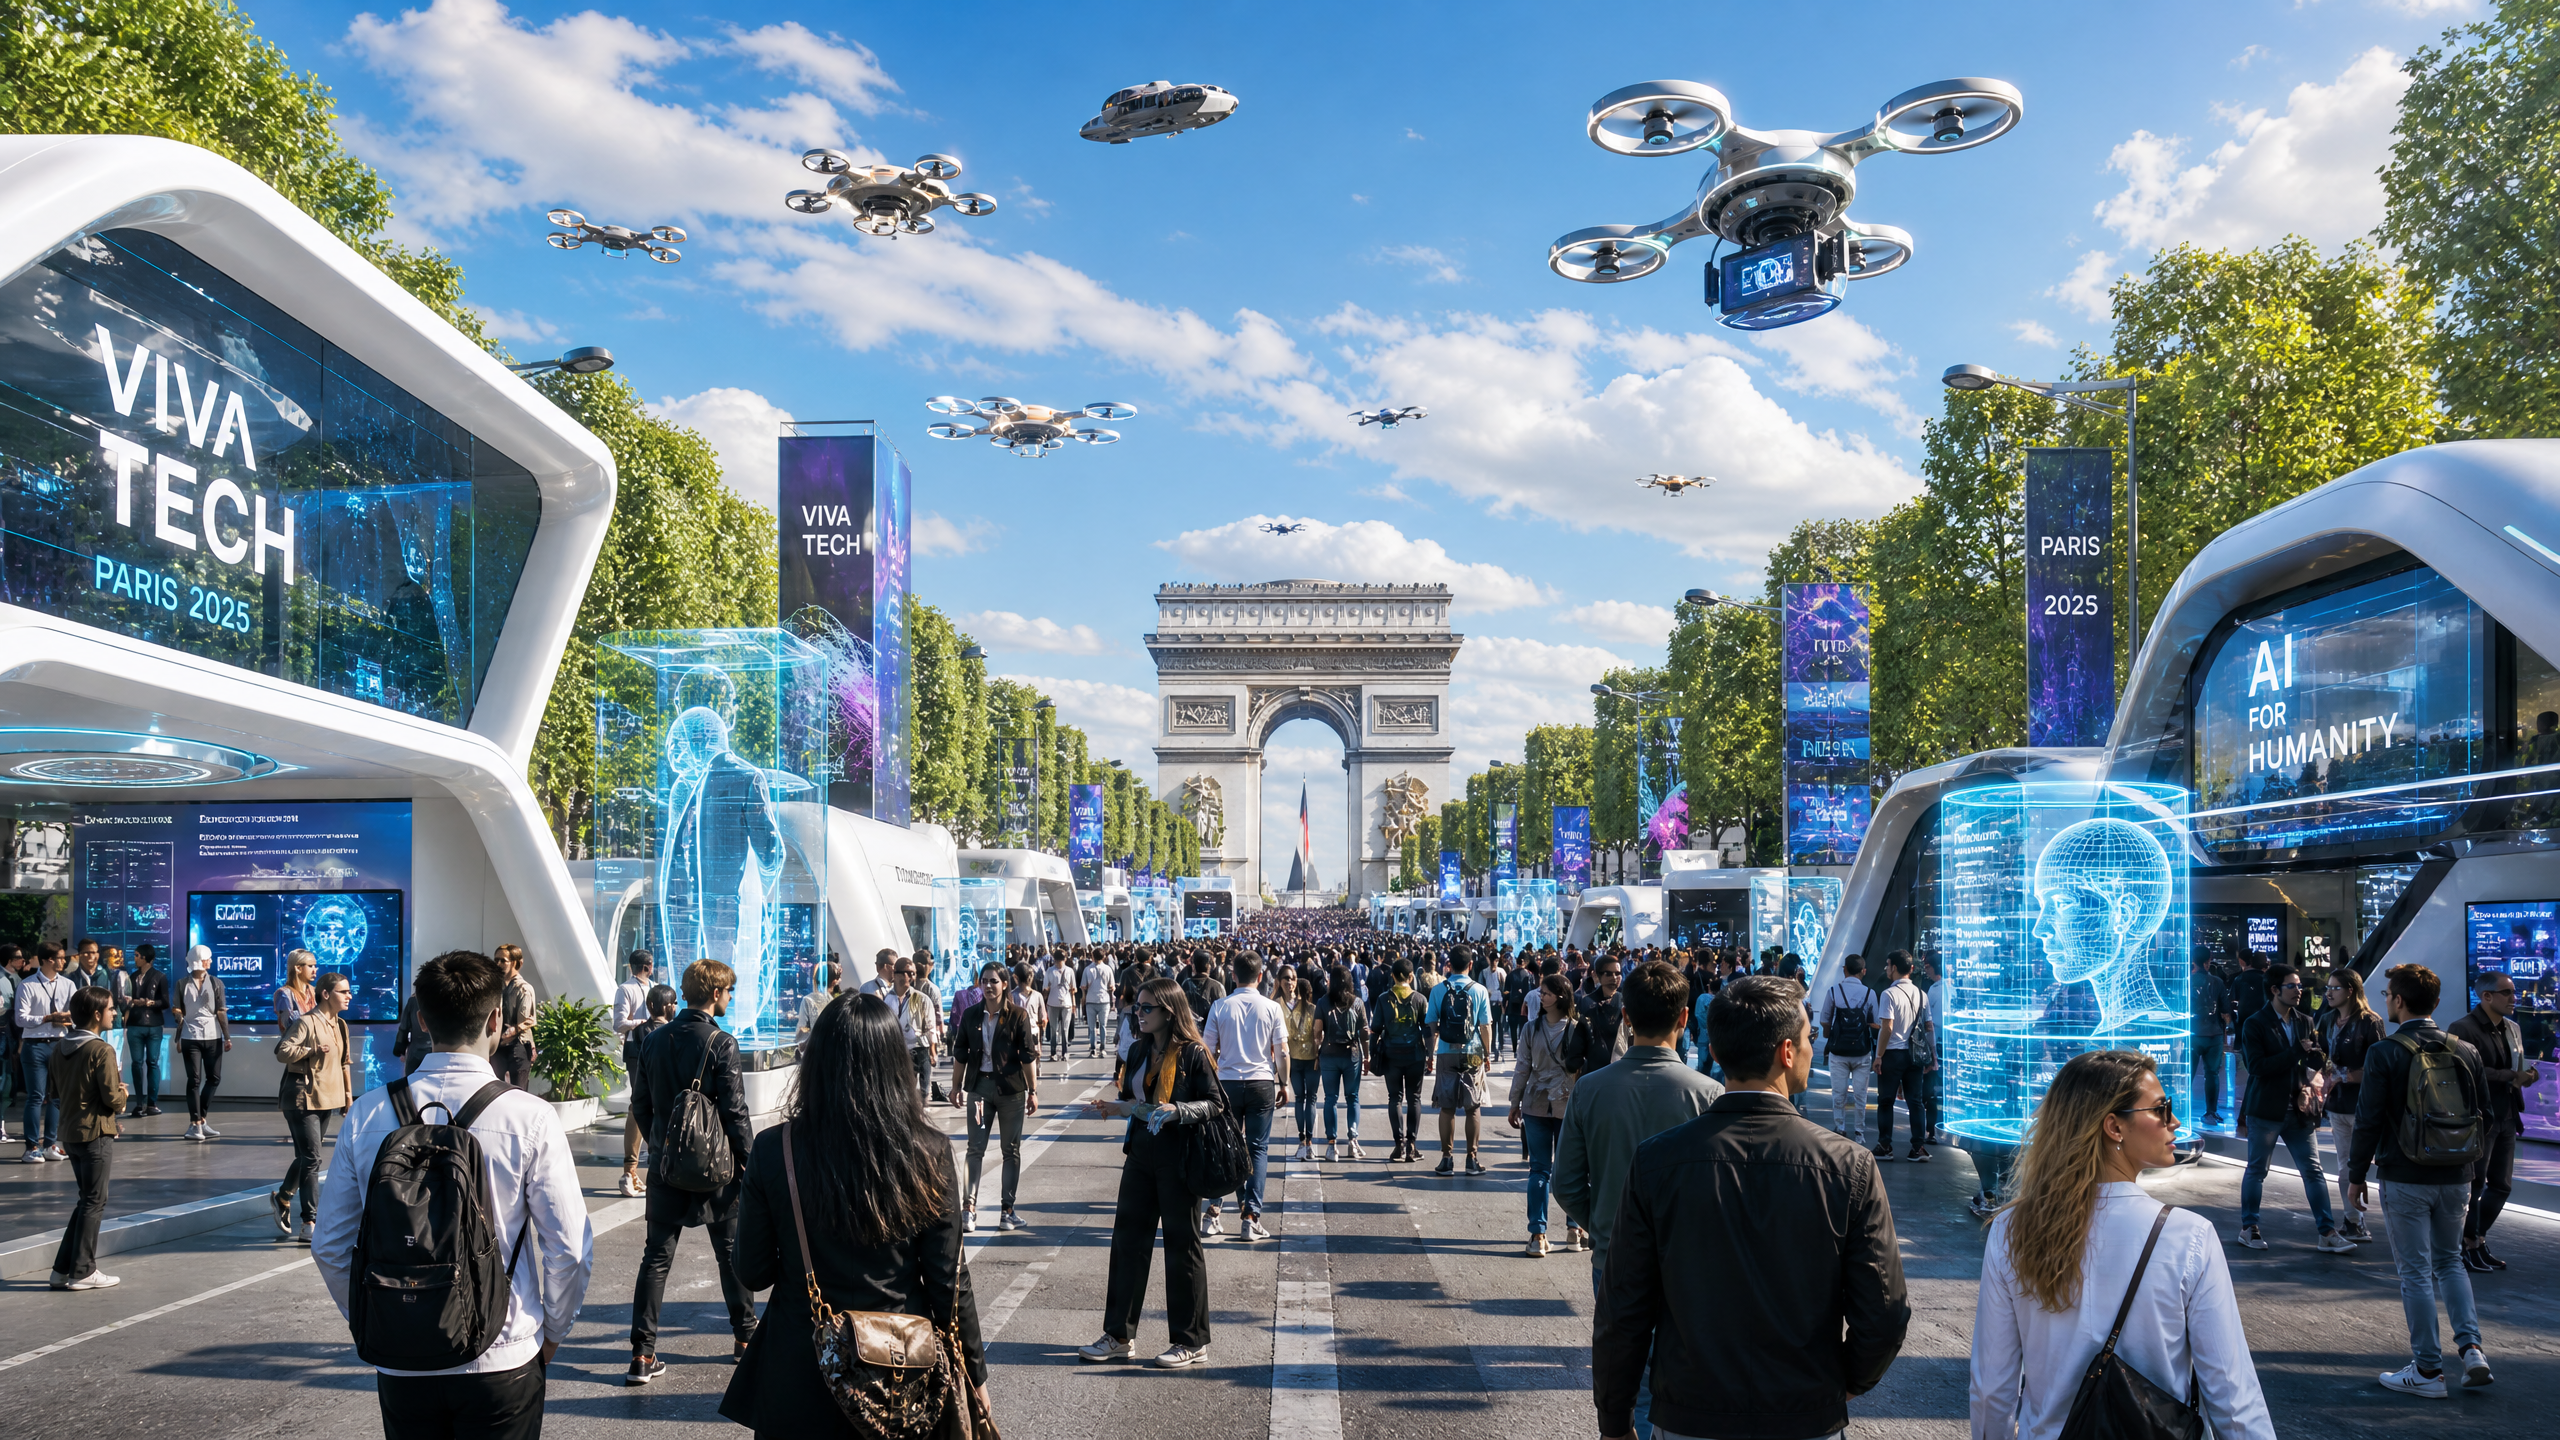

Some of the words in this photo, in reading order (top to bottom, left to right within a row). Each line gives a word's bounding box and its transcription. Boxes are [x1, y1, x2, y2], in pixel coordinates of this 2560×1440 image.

[95, 323, 257, 472] VIVA
[99, 429, 295, 586] TECH
[802, 505, 852, 526] VIVA
[802, 534, 860, 556] TECH
[2041, 536, 2101, 556] PARIS
[95, 555, 178, 611] PARIS
[189, 585, 250, 634] 2025
[2044, 595, 2099, 616] 2025
[2248, 633, 2293, 698] AI
[2249, 701, 2287, 732] FOR
[2249, 712, 2398, 773] HUMANITY
